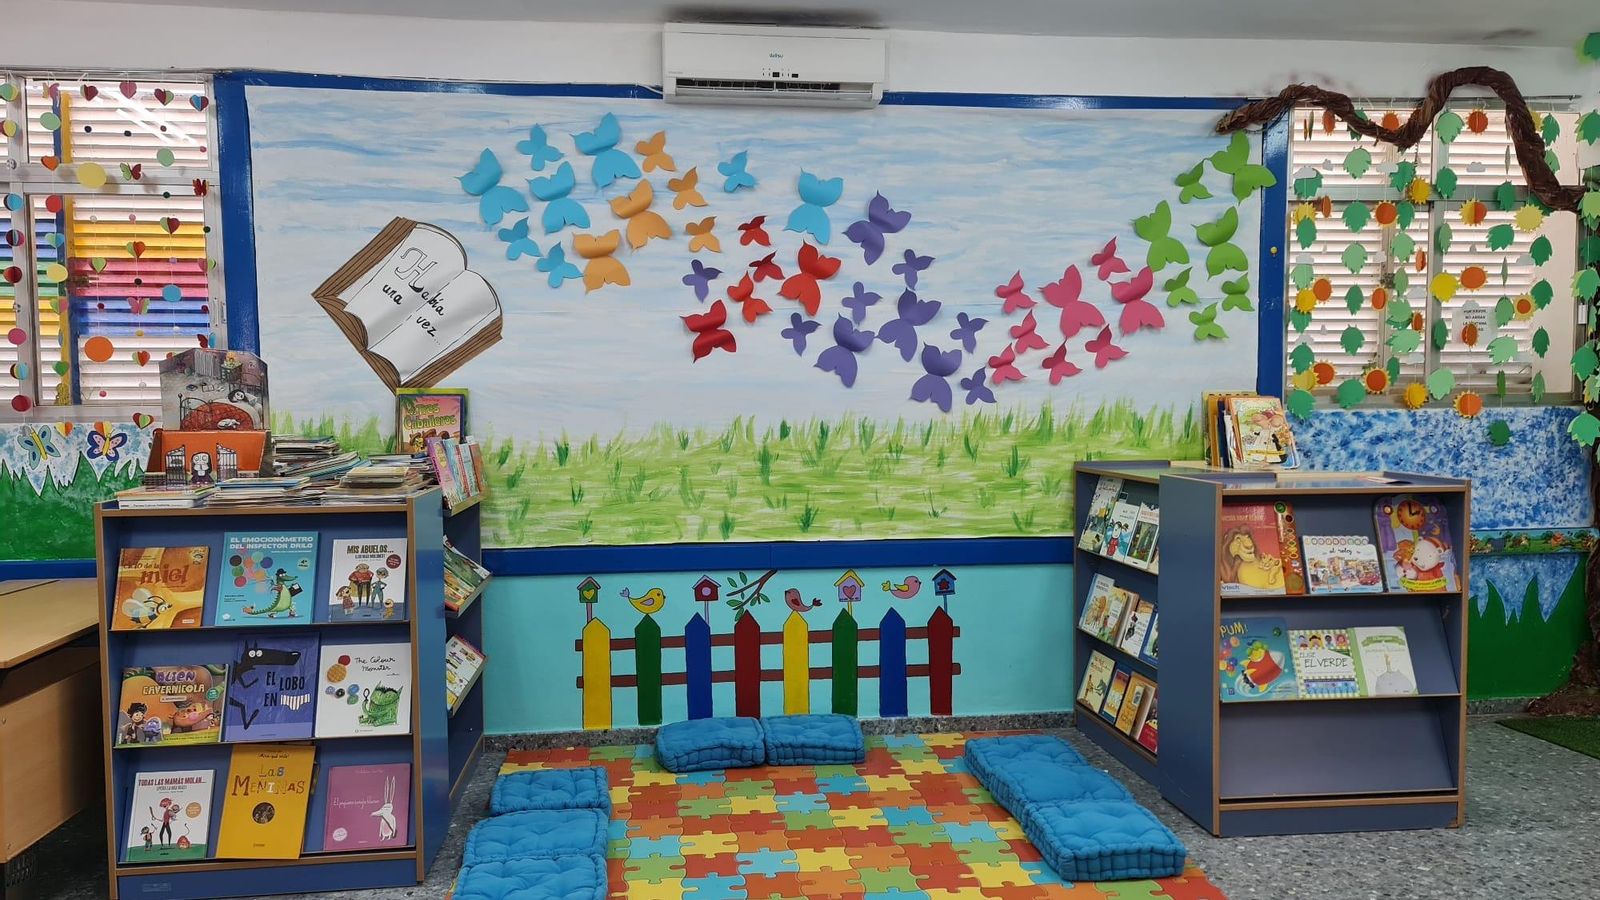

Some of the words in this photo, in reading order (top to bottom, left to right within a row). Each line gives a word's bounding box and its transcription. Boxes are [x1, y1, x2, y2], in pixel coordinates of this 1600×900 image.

[382, 283, 404, 306] una
[347, 545, 360, 555] MIS
[140, 564, 190, 585] miel
[1317, 657, 1348, 668] VERDE
[266, 671, 276, 686] EL
[280, 676, 305, 691] LOBO
[264, 693, 278, 706] EN
[154, 778, 164, 786] LAS
